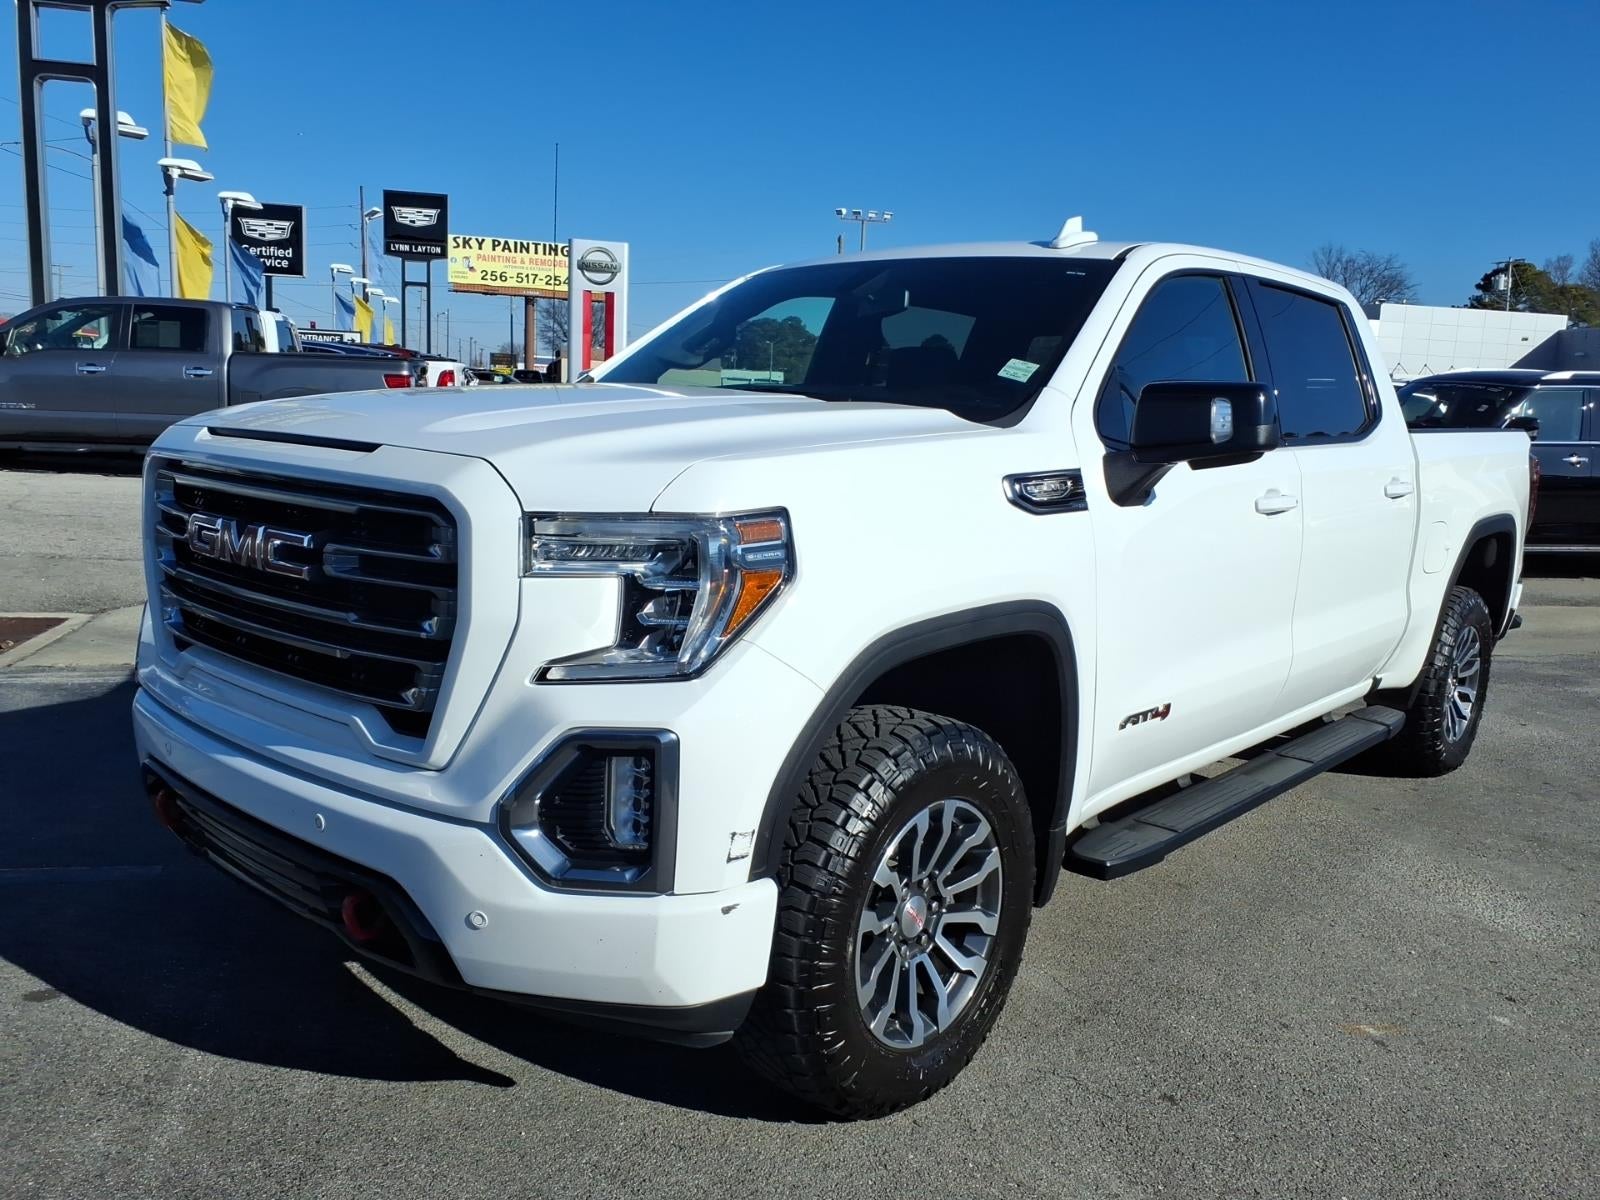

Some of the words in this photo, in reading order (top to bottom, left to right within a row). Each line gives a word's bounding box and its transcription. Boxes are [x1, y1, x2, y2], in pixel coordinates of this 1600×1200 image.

[390, 243, 410, 252] LYNN
[412, 245, 442, 254] LAYTON
[452, 236, 486, 250] SKY
[492, 239, 569, 257] PAINTING
[476, 253, 517, 265] PAINTING
[581, 261, 618, 271] NISSAN
[188, 512, 313, 581] GMC
[1118, 702, 1172, 731] AT4
